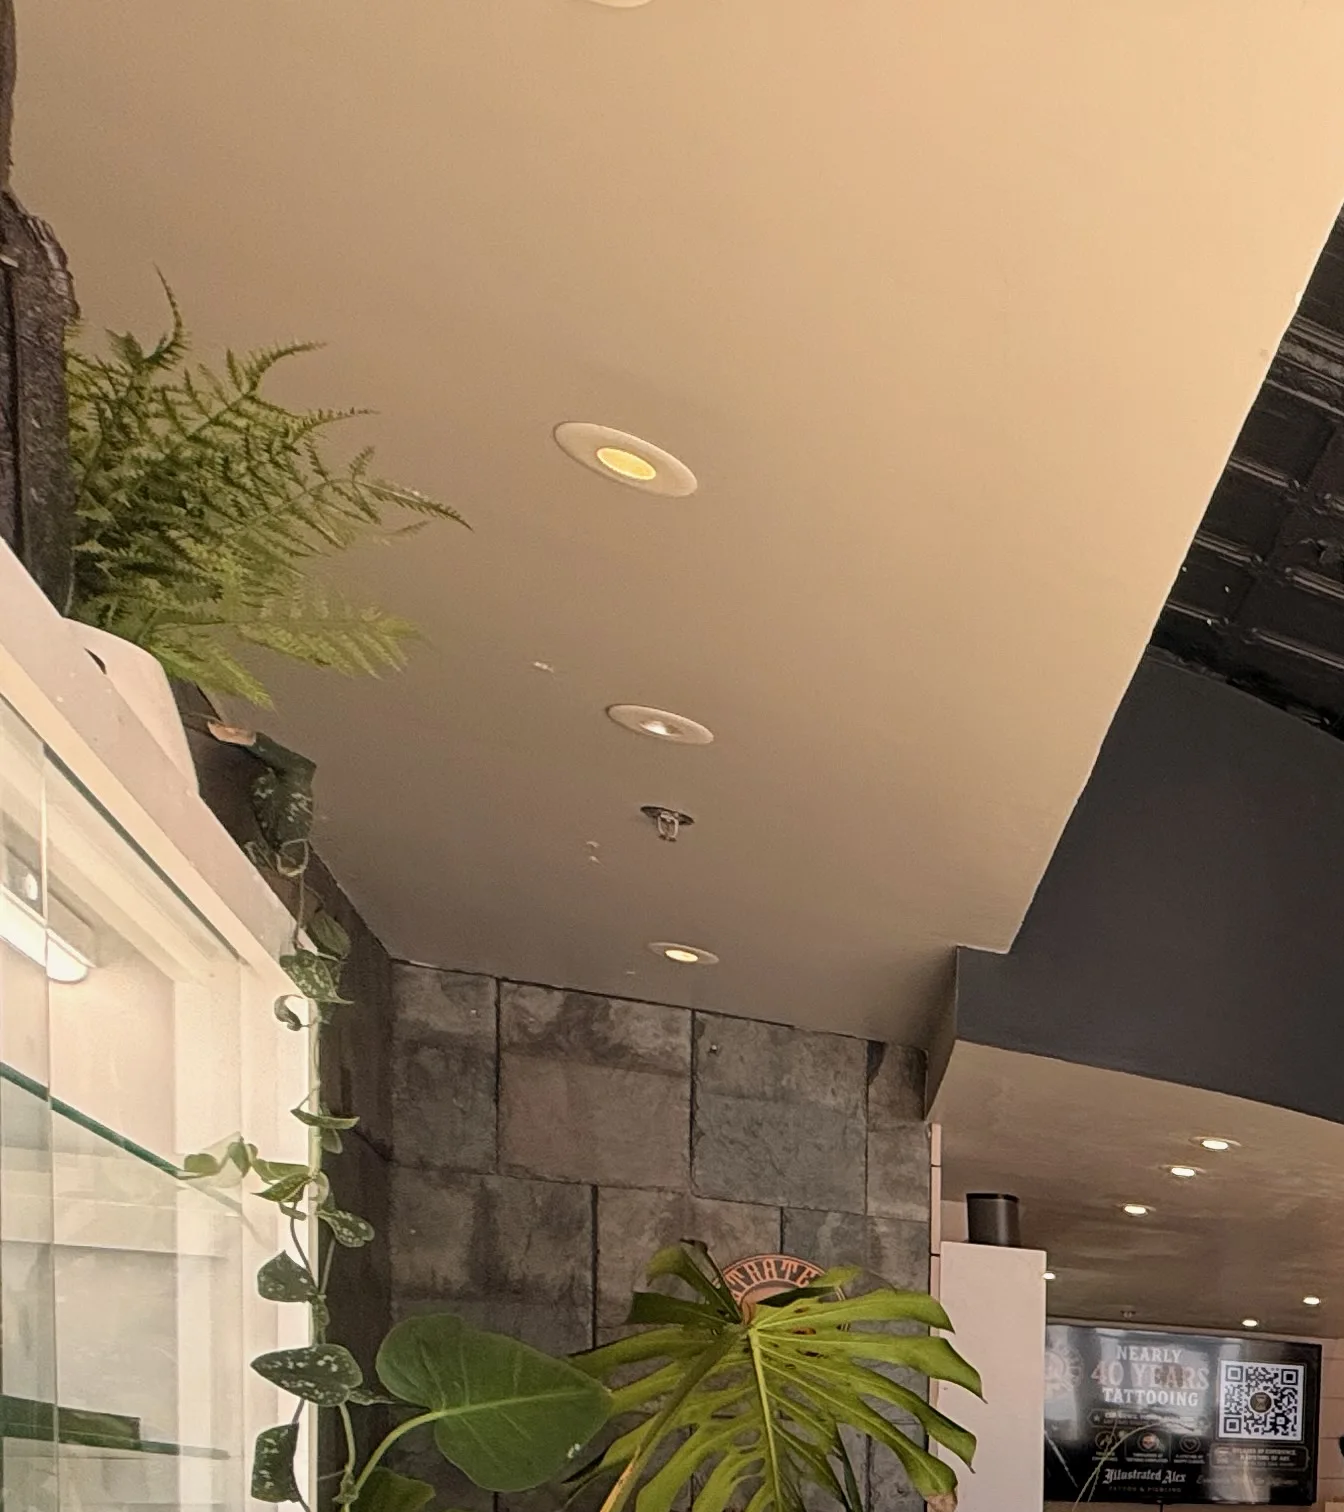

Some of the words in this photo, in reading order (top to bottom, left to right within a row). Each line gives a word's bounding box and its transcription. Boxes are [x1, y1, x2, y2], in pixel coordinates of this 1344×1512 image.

[1116, 1345, 1183, 1363] NEARLY
[1091, 1360, 1124, 1387] 40
[1130, 1362, 1210, 1391] YEARS
[1101, 1387, 1199, 1407] TATTOOING
[1102, 1468, 1162, 1485] Illustrated
[1162, 1469, 1187, 1484] Alex
